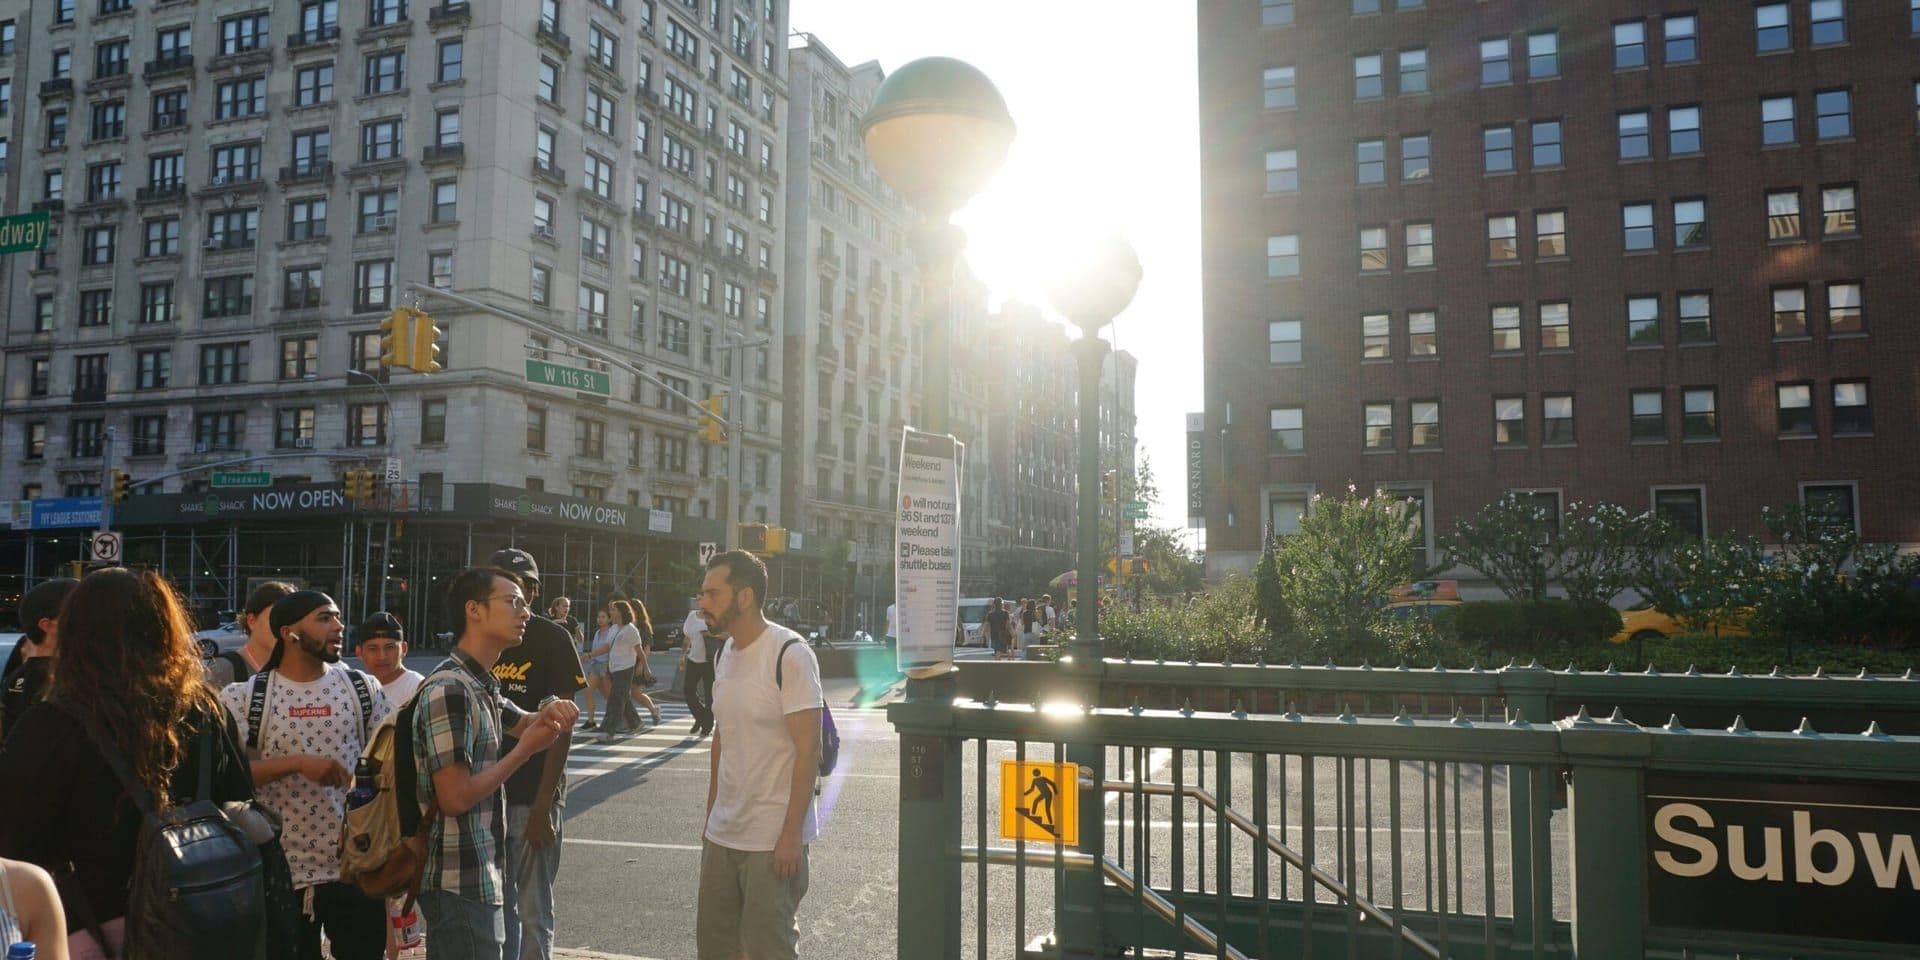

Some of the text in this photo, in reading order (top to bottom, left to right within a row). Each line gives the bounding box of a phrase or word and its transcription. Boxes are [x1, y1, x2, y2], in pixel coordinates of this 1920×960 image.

[544, 366, 595, 389] W 116 St
[904, 456, 941, 471] Weekend
[387, 470, 400, 480] 25
[1192, 440, 1201, 508] BARNARD
[179, 489, 344, 513] SHAKE SHACK NOW OPEN
[912, 497, 927, 509] will
[927, 499, 941, 510] not
[494, 498, 626, 526] SHAKE SHACK NOW OPEN
[901, 510, 912, 522] 96
[923, 513, 940, 524] and
[900, 525, 939, 537] weekend
[911, 544, 940, 556] Please
[900, 558, 928, 570] shuttle
[911, 744, 927, 754] 116
[1654, 802, 1920, 891] Subw
